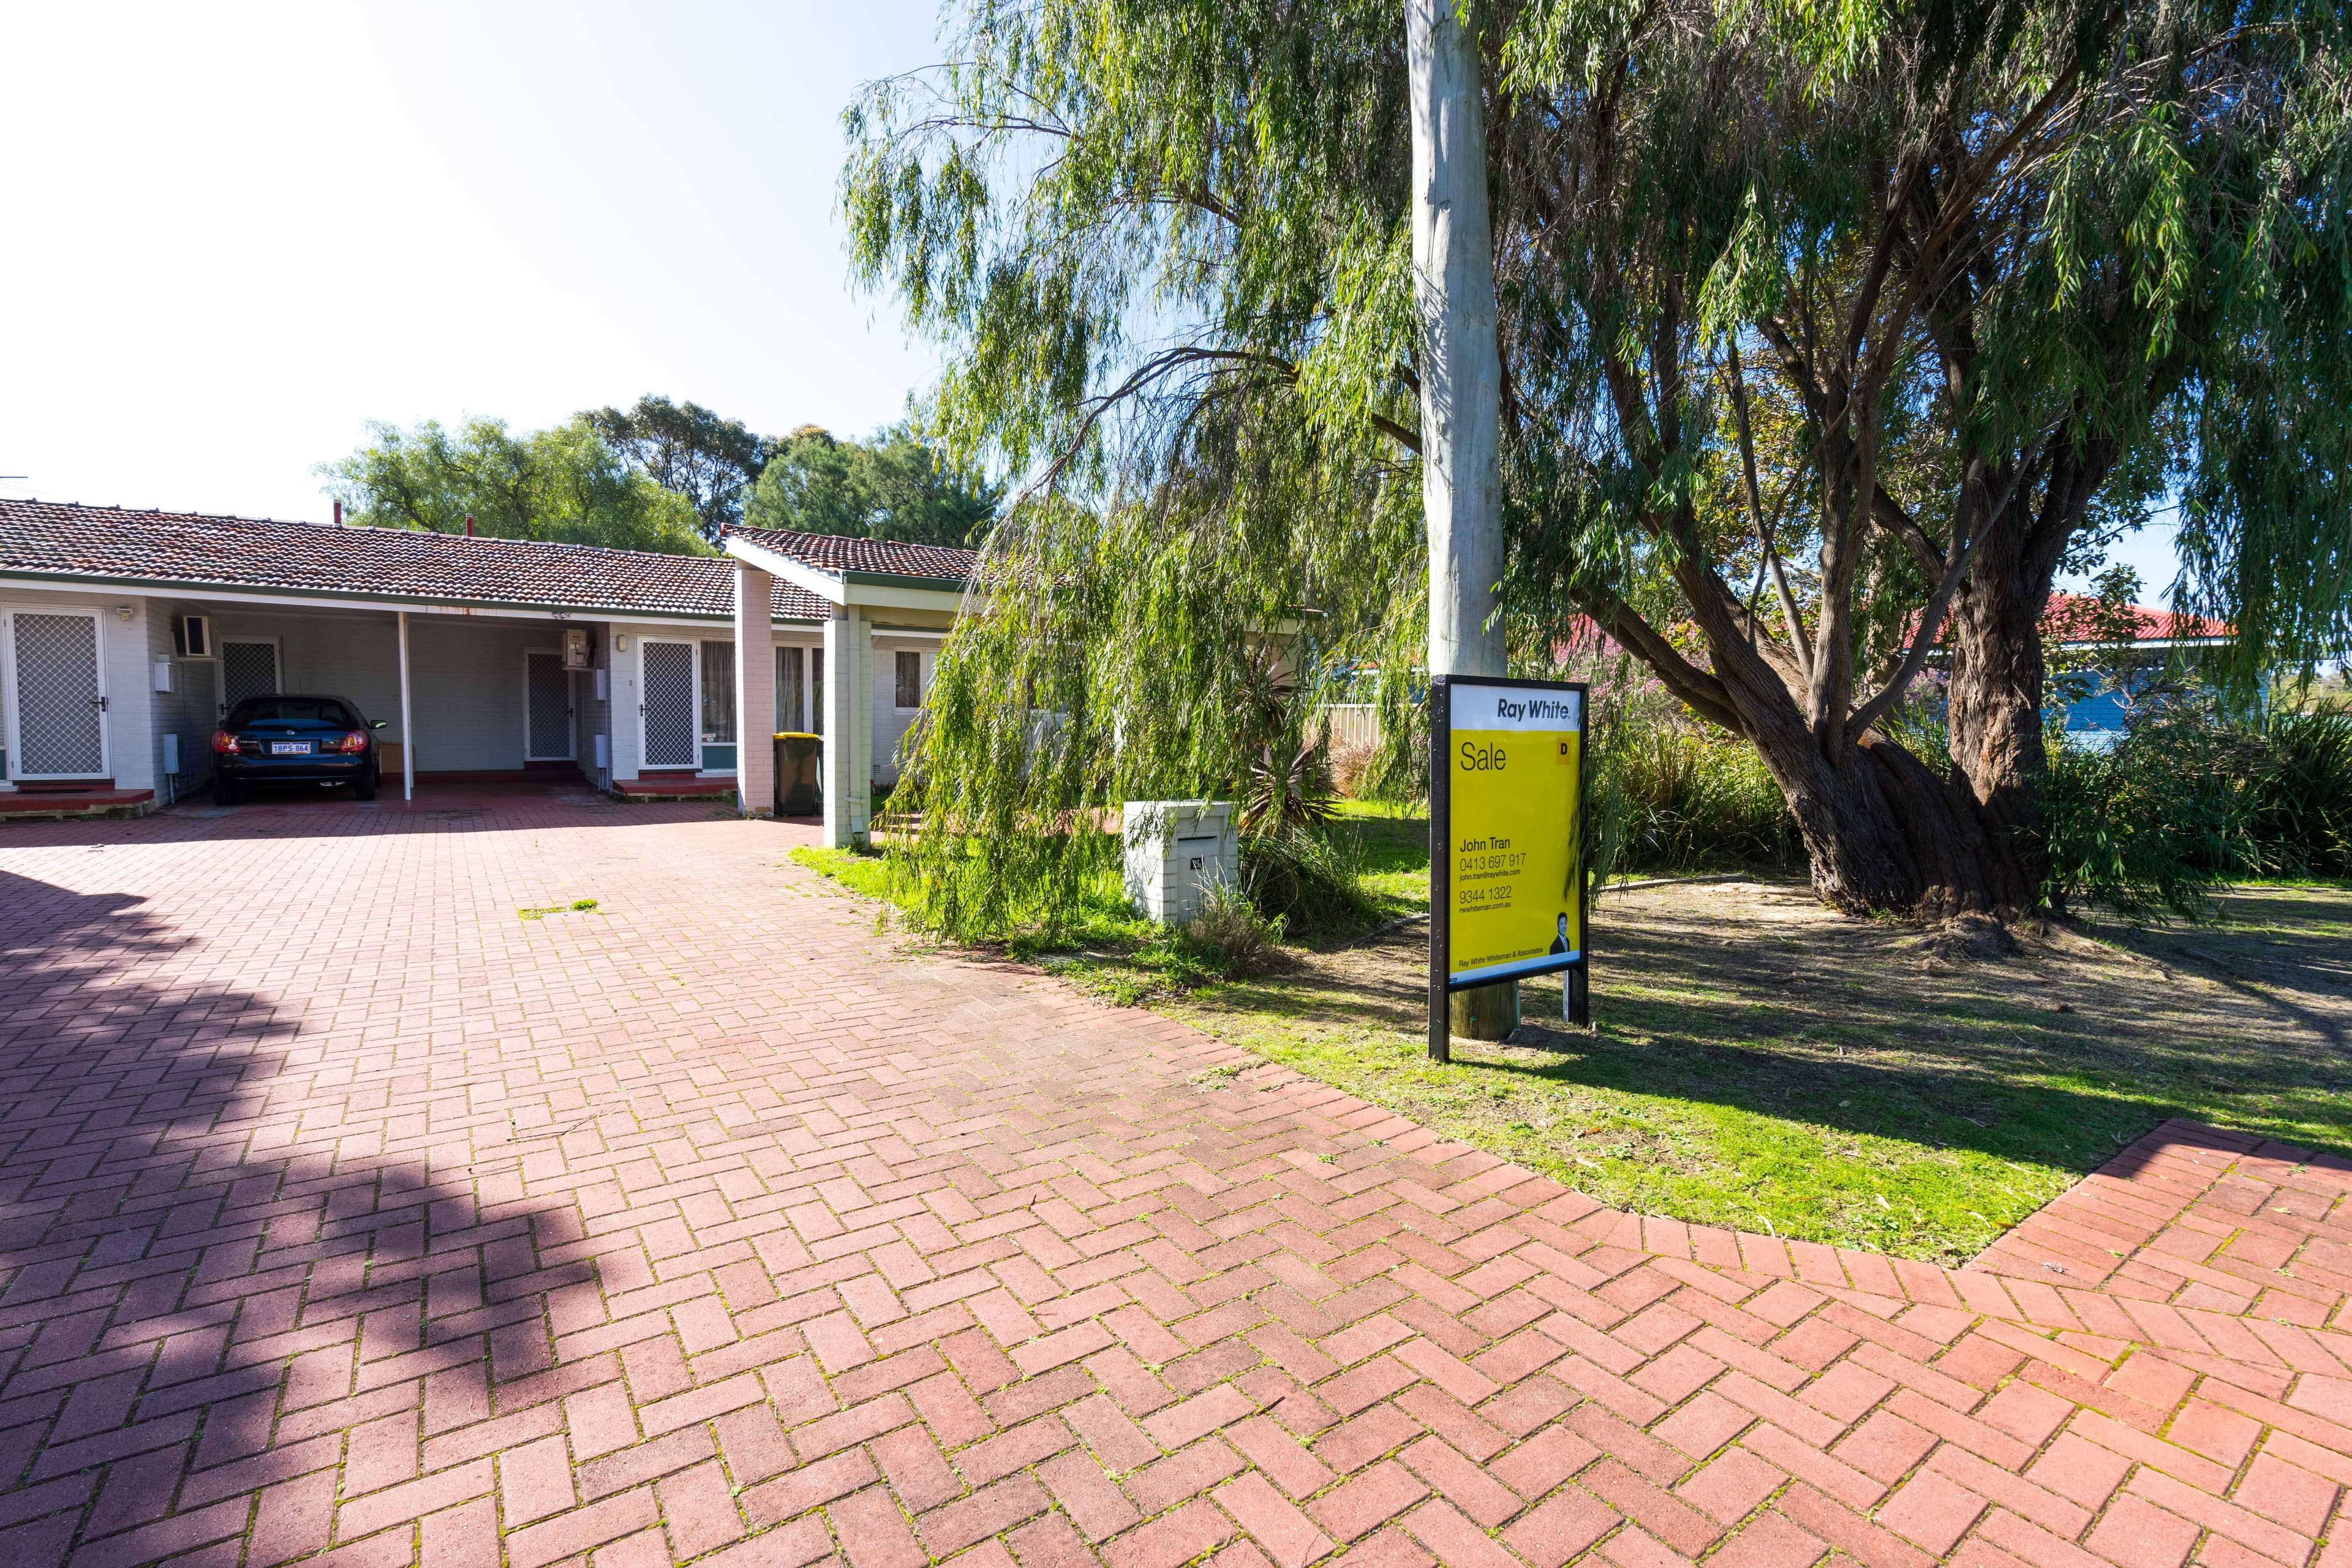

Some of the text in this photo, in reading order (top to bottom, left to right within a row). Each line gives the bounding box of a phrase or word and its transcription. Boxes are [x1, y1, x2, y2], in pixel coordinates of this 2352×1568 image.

[1497, 698, 1526, 722] Ray
[1461, 742, 1506, 771] Sale
[1561, 743, 1567, 755] D
[1460, 837, 1510, 852] John Tran
[1460, 853, 1526, 871] 0413 697 917
[1460, 869, 1520, 882] john.tran@raywhite.com
[1460, 886, 1512, 904] 9344 1322
[1460, 902, 1511, 914] rwwhiteman.com.au
[1487, 952, 1511, 963] Whiteman
[1517, 947, 1543, 956] Associates
